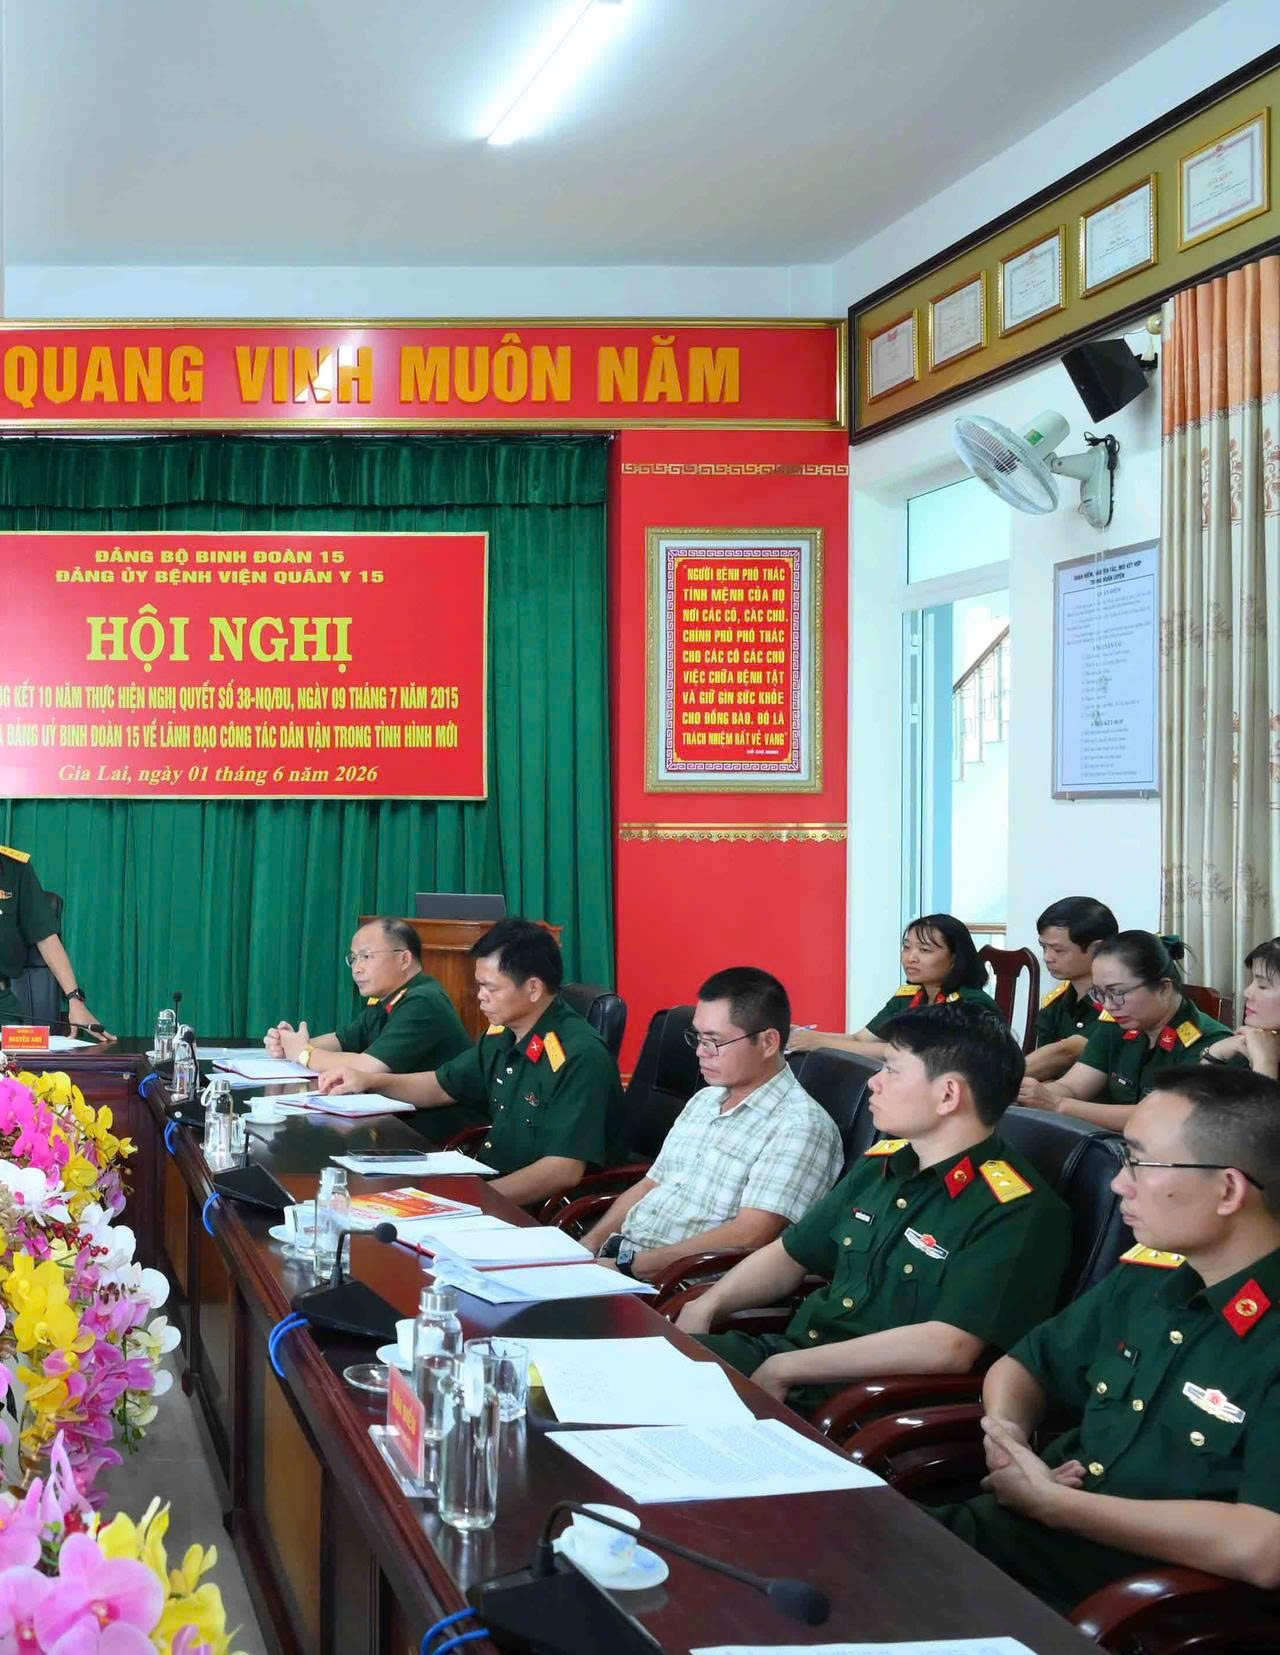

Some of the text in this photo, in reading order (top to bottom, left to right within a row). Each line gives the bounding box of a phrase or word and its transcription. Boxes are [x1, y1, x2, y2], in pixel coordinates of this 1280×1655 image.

[4, 346, 204, 408] QUANG
[237, 345, 373, 403] VINH
[400, 332, 582, 404] MUÔN
[598, 337, 741, 404] NĂM
[95, 547, 345, 565] ĐẢNG BỘ BINH ĐOÀN 15
[56, 566, 384, 585] ĐẢNG ỦY BỆNH VIỆN QUÂN Y 15
[86, 603, 352, 673] HỘI NGHỊ
[14, 677, 35, 708] KẾT
[40, 686, 52, 708] 10
[56, 682, 82, 708] NĂM
[86, 684, 115, 713] THỰC
[118, 682, 145, 713] HIỆN
[149, 686, 176, 713] NGHỊ
[180, 680, 215, 711] QUYẾT
[219, 679, 234, 709] SỐ
[298, 682, 329, 709] NGÀY
[332, 687, 346, 709] 09
[349, 682, 387, 709] THÁNG
[390, 687, 397, 709] 7
[400, 682, 428, 709] NĂM
[431, 687, 459, 709] 2015
[7, 717, 38, 746] ĐẢNG
[60, 724, 88, 747] BINH
[91, 720, 122, 748] ĐOÀN
[126, 725, 139, 748] 15
[142, 718, 157, 748] VỀ
[160, 721, 191, 748] LÃNH
[193, 725, 217, 753] ĐẠO
[220, 721, 252, 748] CÔNG
[255, 721, 277, 748] TÁC
[280, 721, 304, 748] DÂN
[307, 721, 330, 753] VẬN
[334, 725, 372, 749] TRONG
[375, 721, 401, 748] TÌNH
[404, 721, 432, 748] HÌNH
[435, 721, 458, 748] MỚI
[58, 765, 378, 787] Gia Lai, ngày 01 tháng 6 năm 2026
